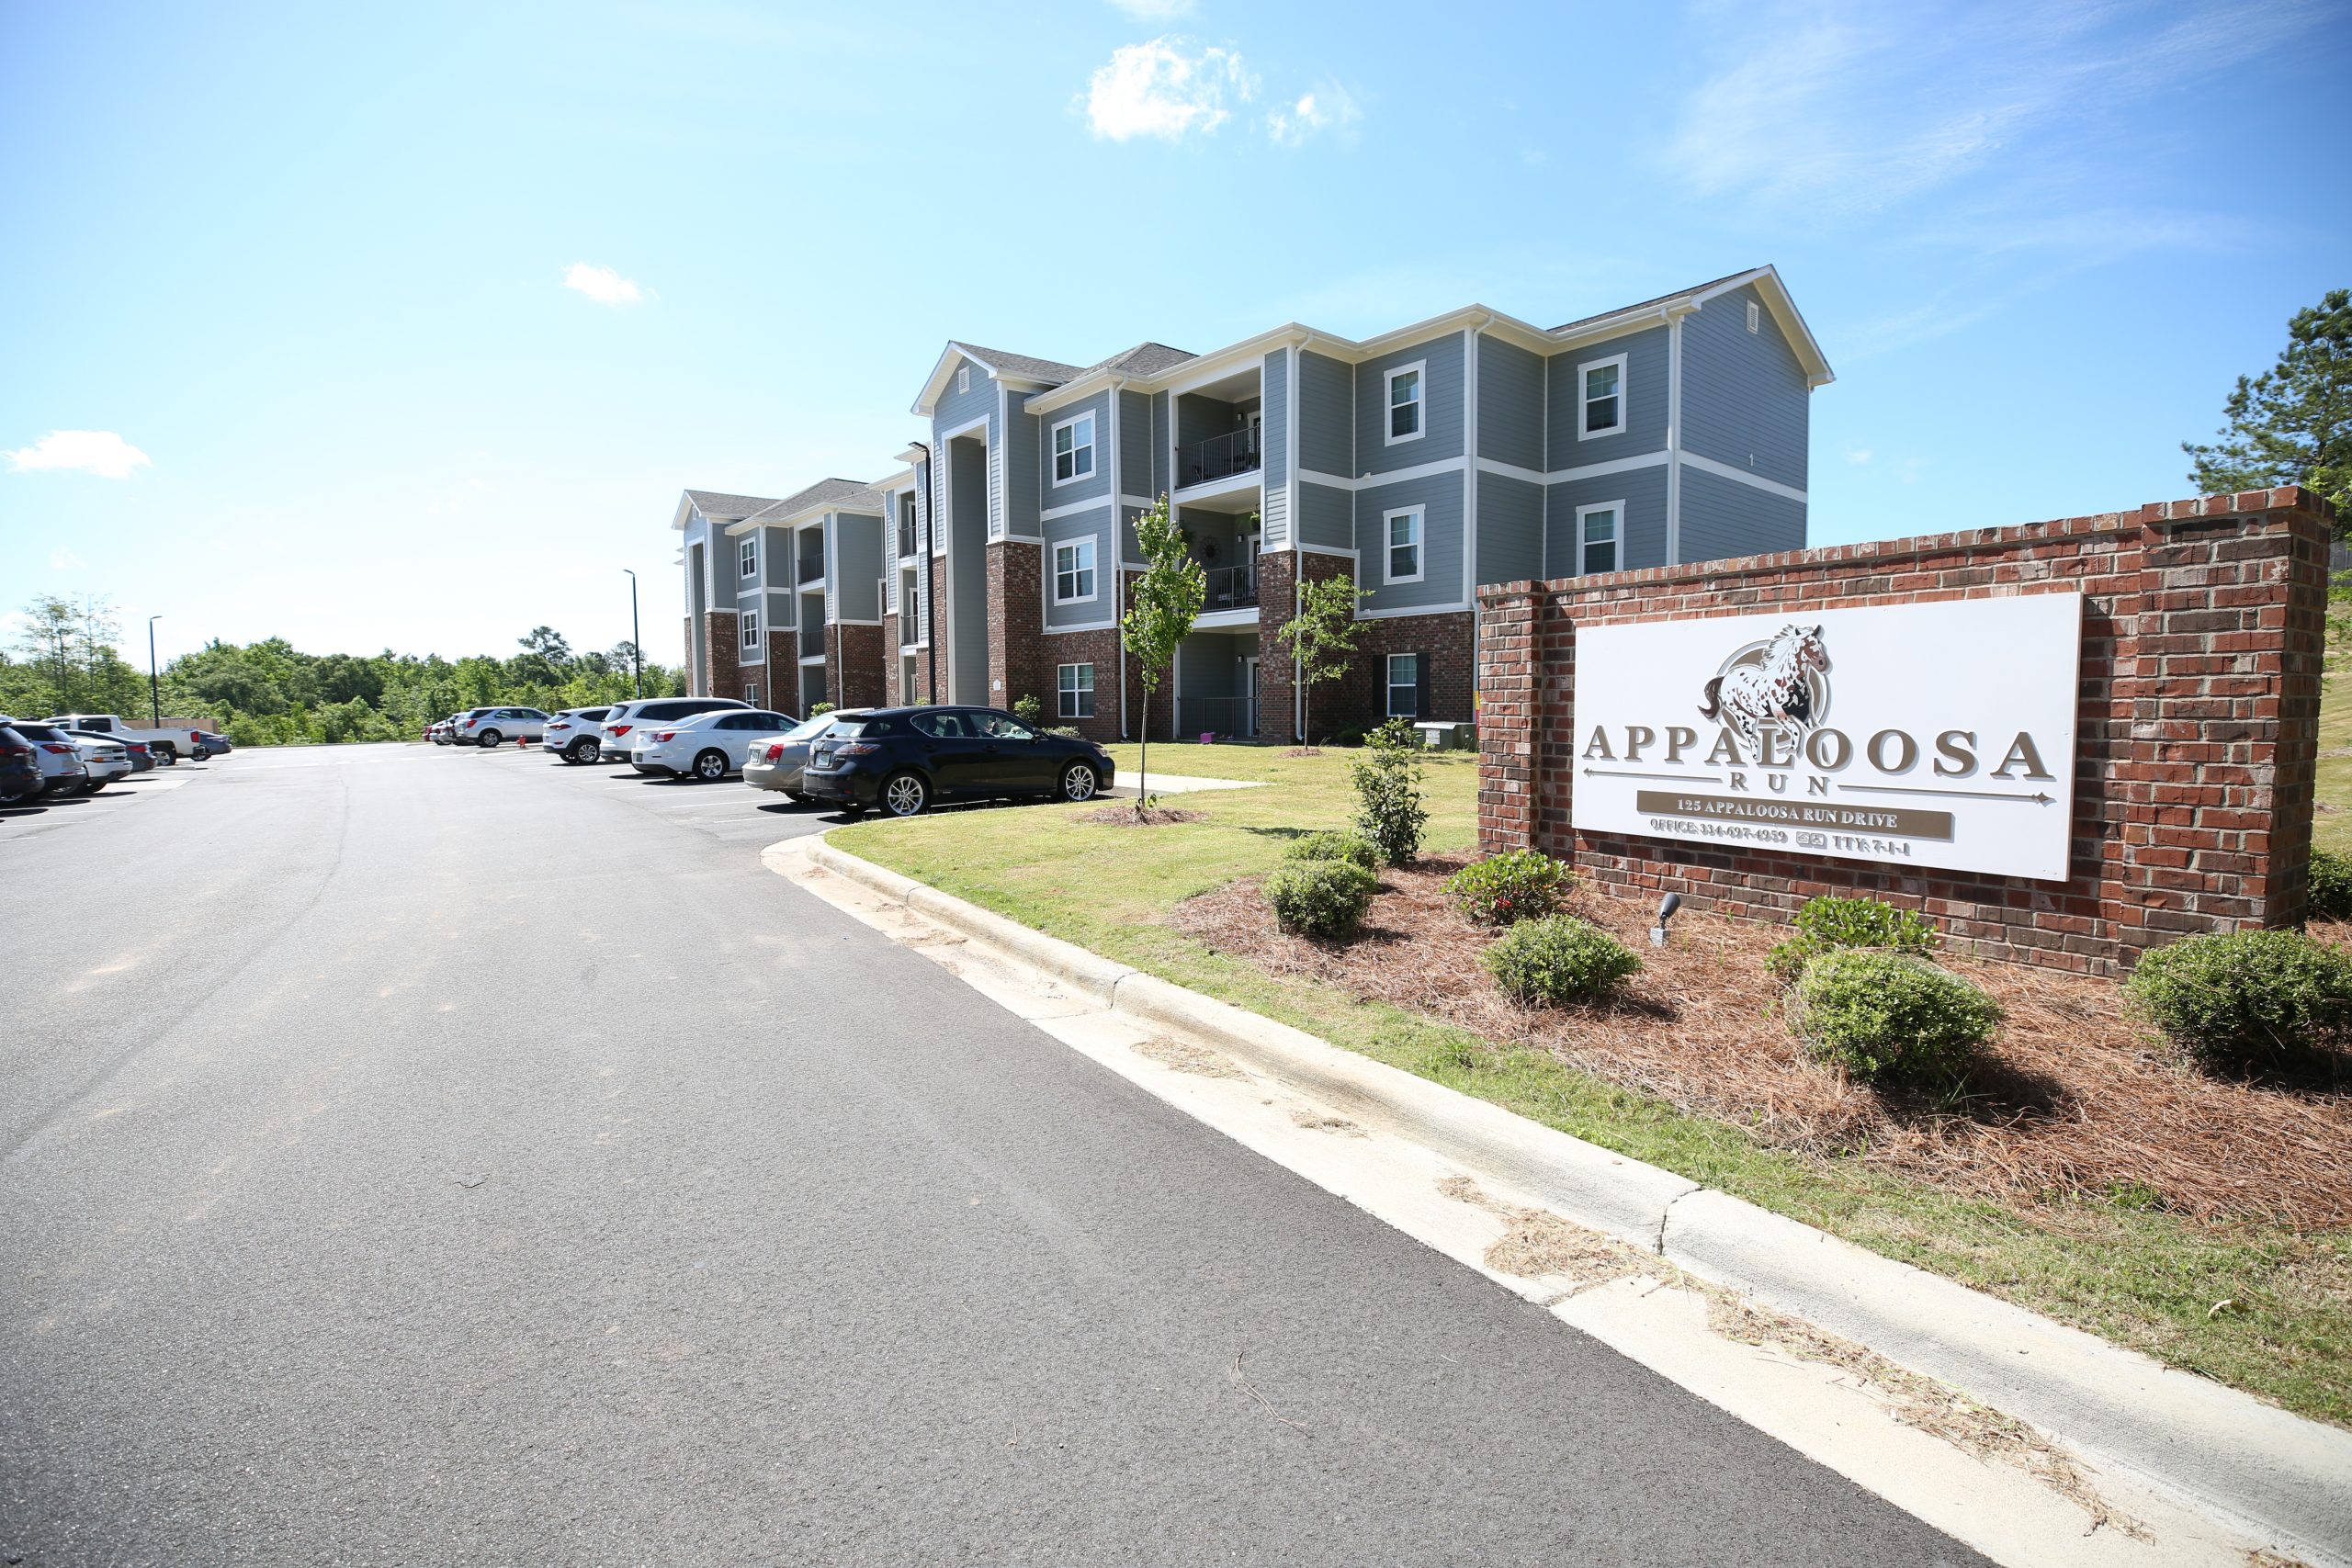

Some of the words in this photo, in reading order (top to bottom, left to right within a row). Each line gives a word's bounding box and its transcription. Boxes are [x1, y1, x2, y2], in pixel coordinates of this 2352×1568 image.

[1581, 725, 2054, 780] APPALOOSA
[1729, 772, 1830, 796] RUN
[1677, 798, 1702, 811] 125
[1704, 800, 1800, 820] APPALOOSA
[1803, 807, 1838, 823] RUN
[1840, 810, 1898, 828] DRIVE
[1650, 818, 1698, 834] OFFICE:
[1700, 823, 1788, 843] 334-697-4959
[1832, 835, 1870, 852] TTY:
[1872, 840, 1910, 856] 7-1-1
